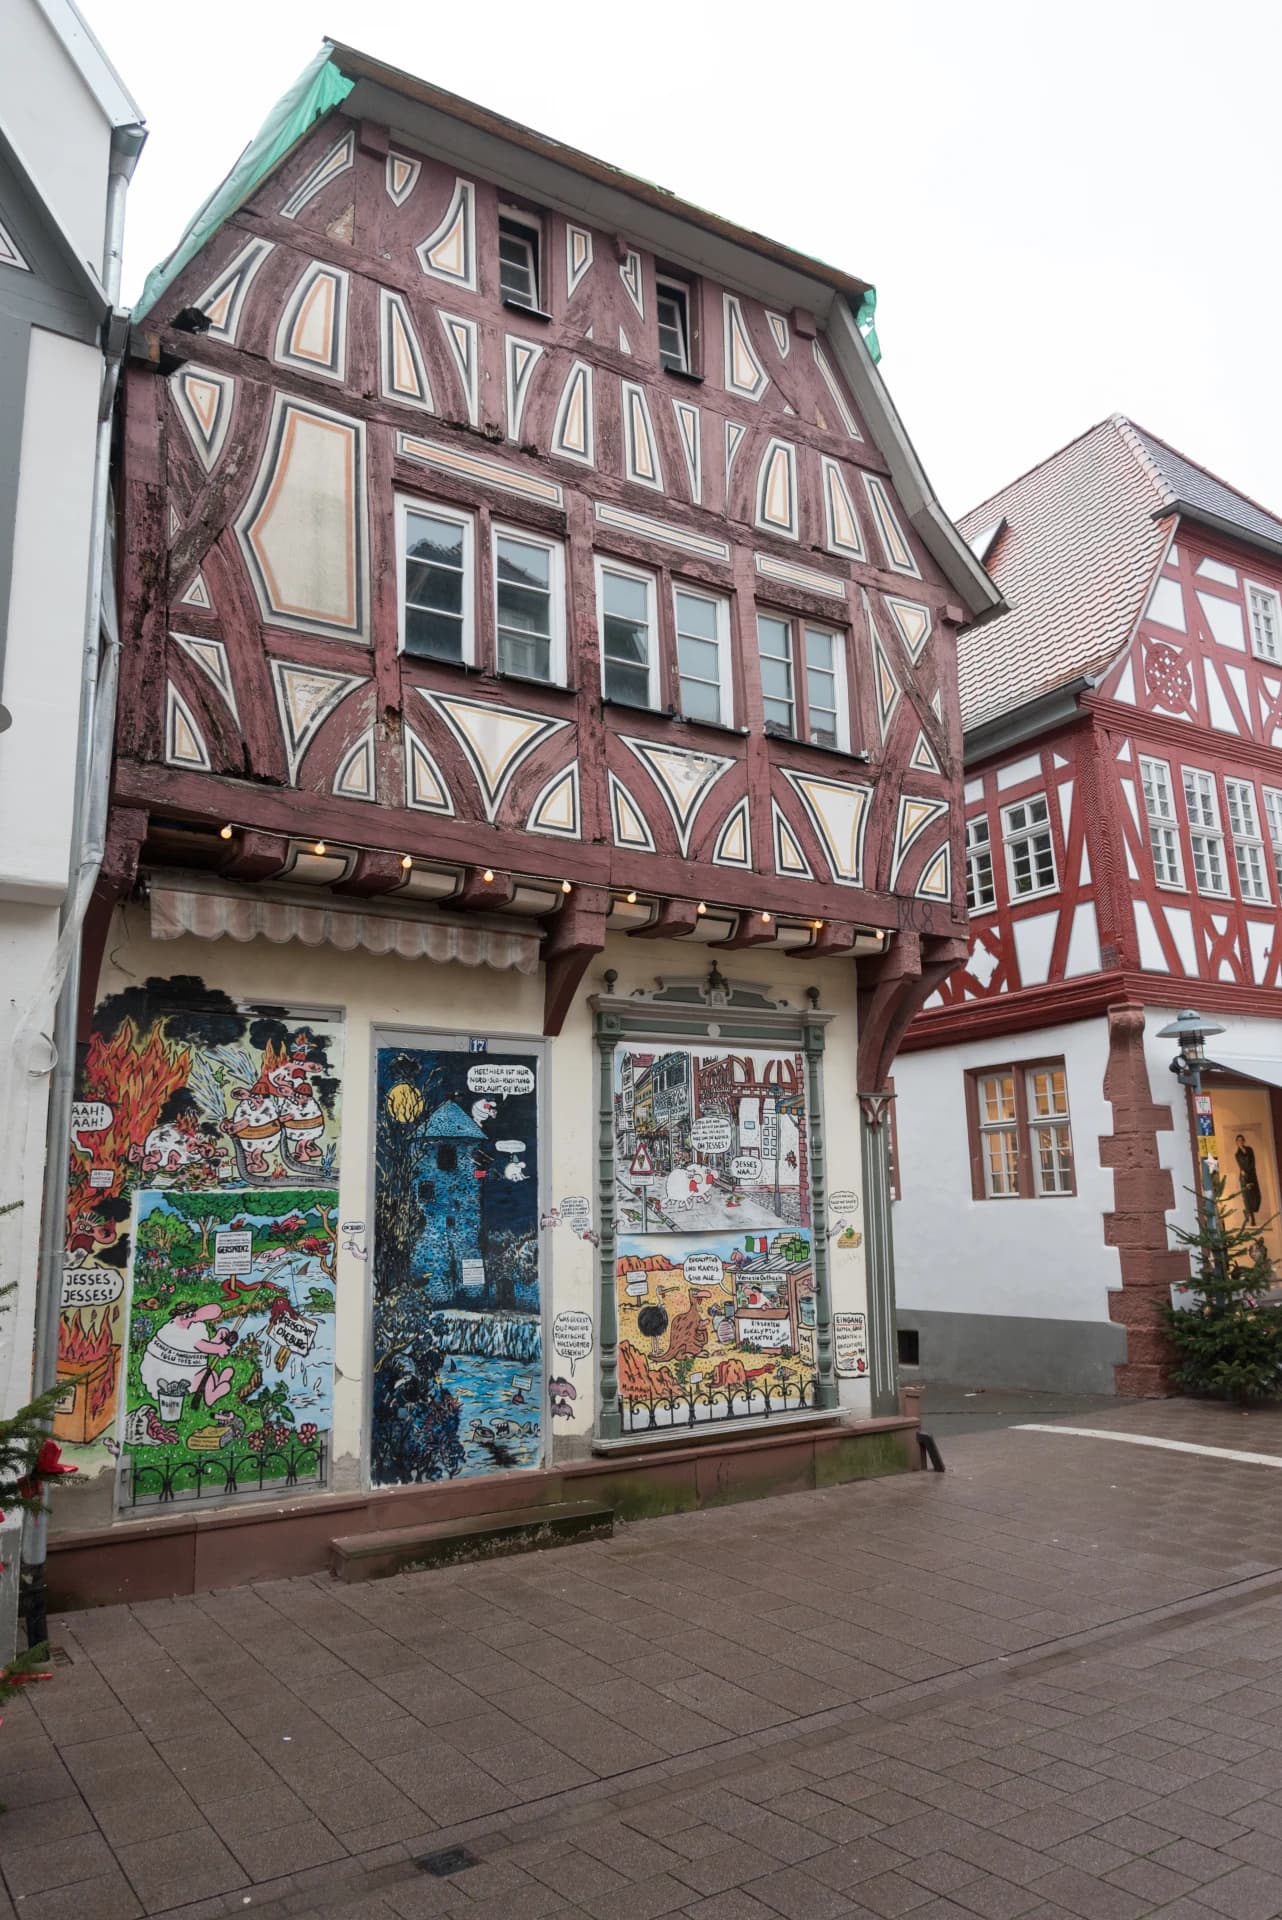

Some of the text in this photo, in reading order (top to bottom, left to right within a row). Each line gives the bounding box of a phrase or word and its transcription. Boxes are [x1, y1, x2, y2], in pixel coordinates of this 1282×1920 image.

[472, 1040, 485, 1052] 17
[706, 1142, 728, 1151] JESSES!
[66, 1273, 116, 1286] JESSES,
[63, 1289, 113, 1303] JESSES!
[836, 1316, 863, 1324] EINGANG
[276, 1327, 306, 1350] DIEBURG
